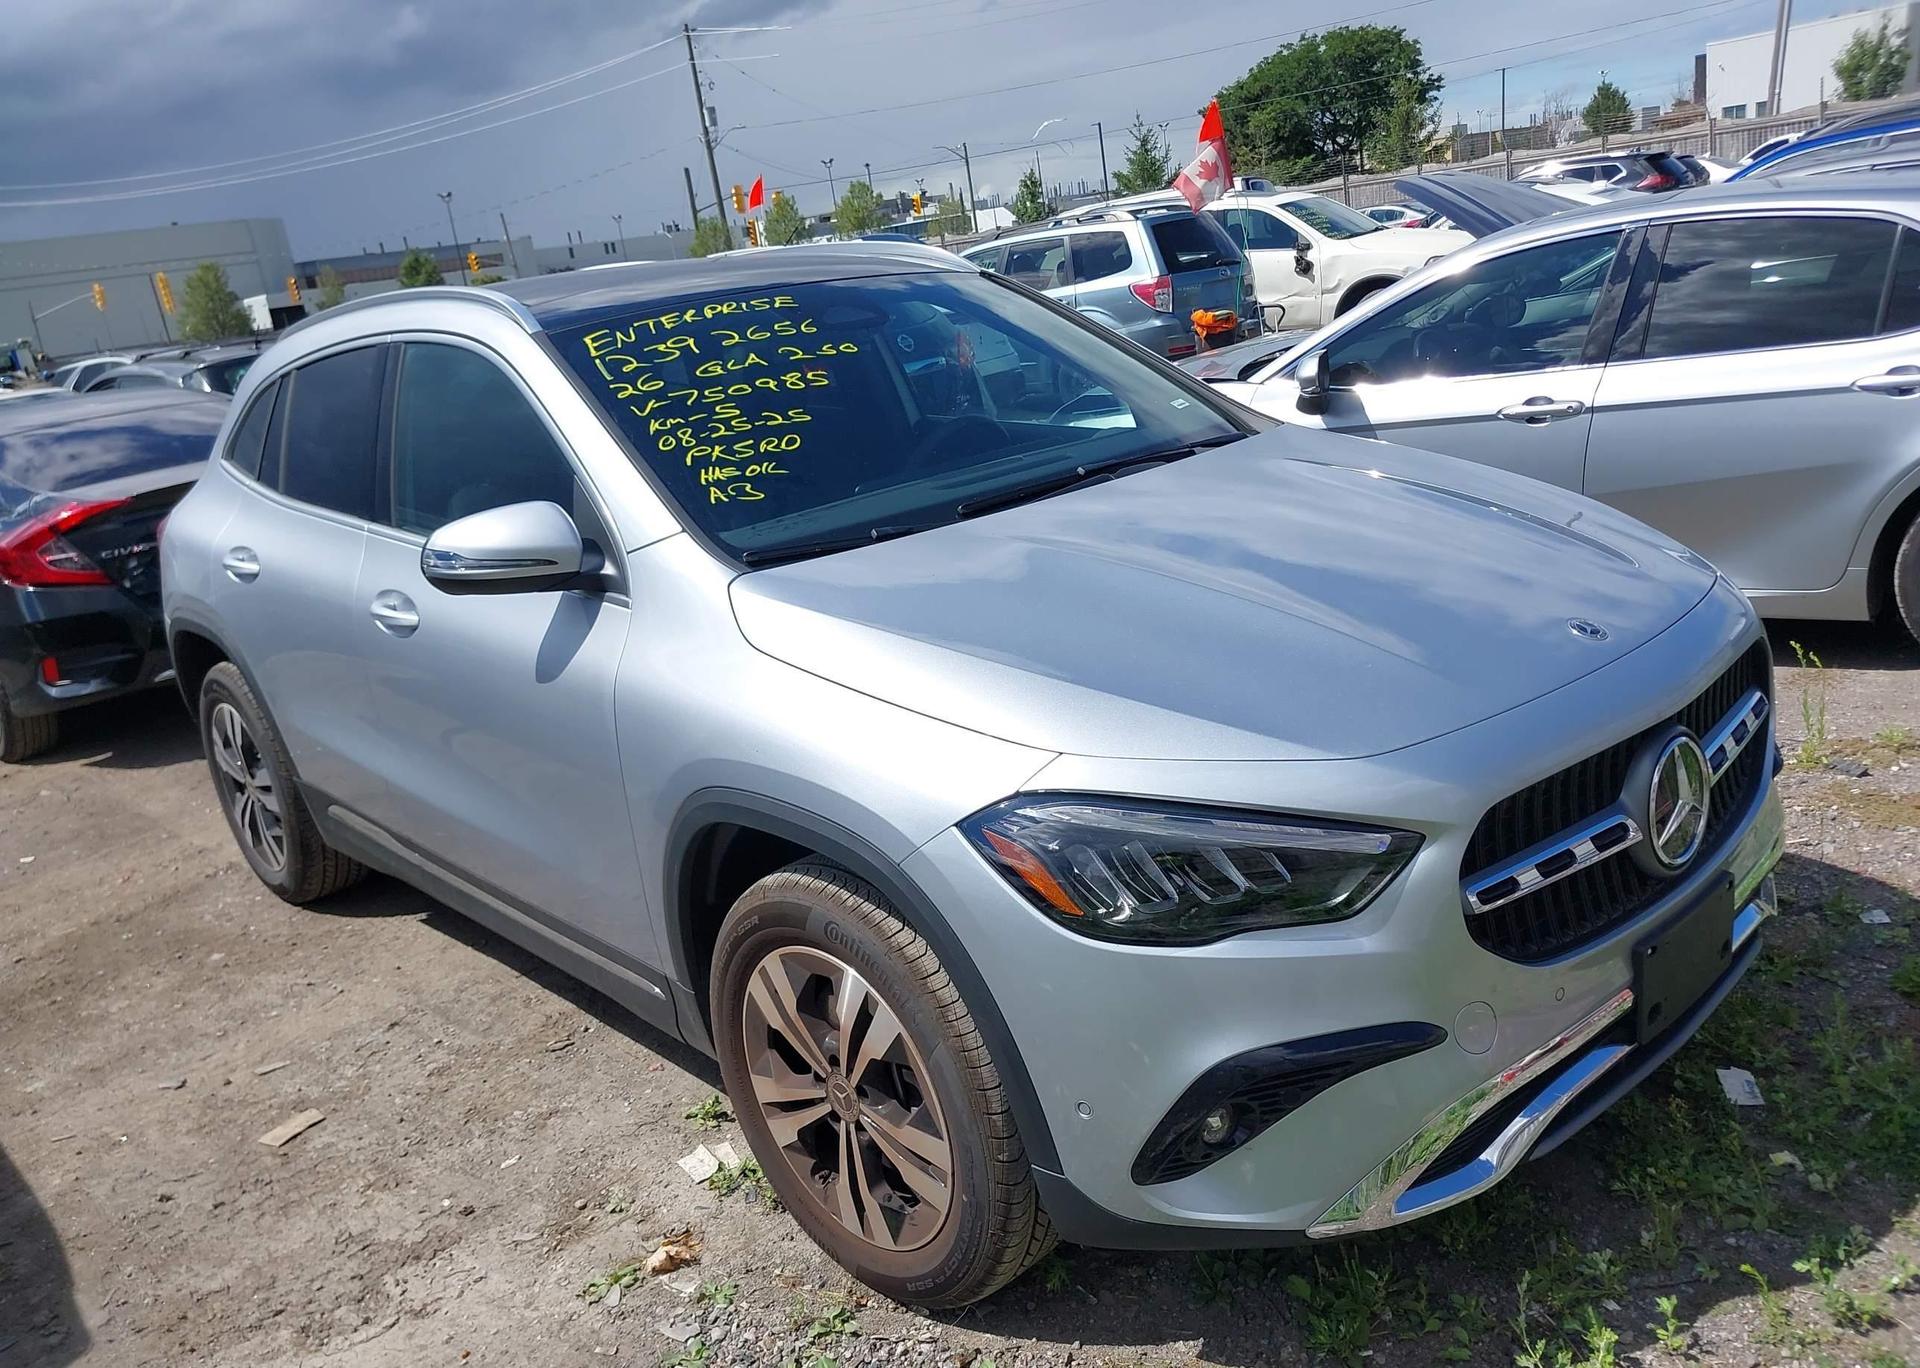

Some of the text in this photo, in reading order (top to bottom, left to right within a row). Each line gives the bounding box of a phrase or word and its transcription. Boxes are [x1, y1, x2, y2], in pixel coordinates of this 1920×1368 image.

[584, 296, 799, 357] ENTERPRISE
[595, 318, 818, 380] 1239 2656
[609, 343, 859, 399] 26 GLA 250
